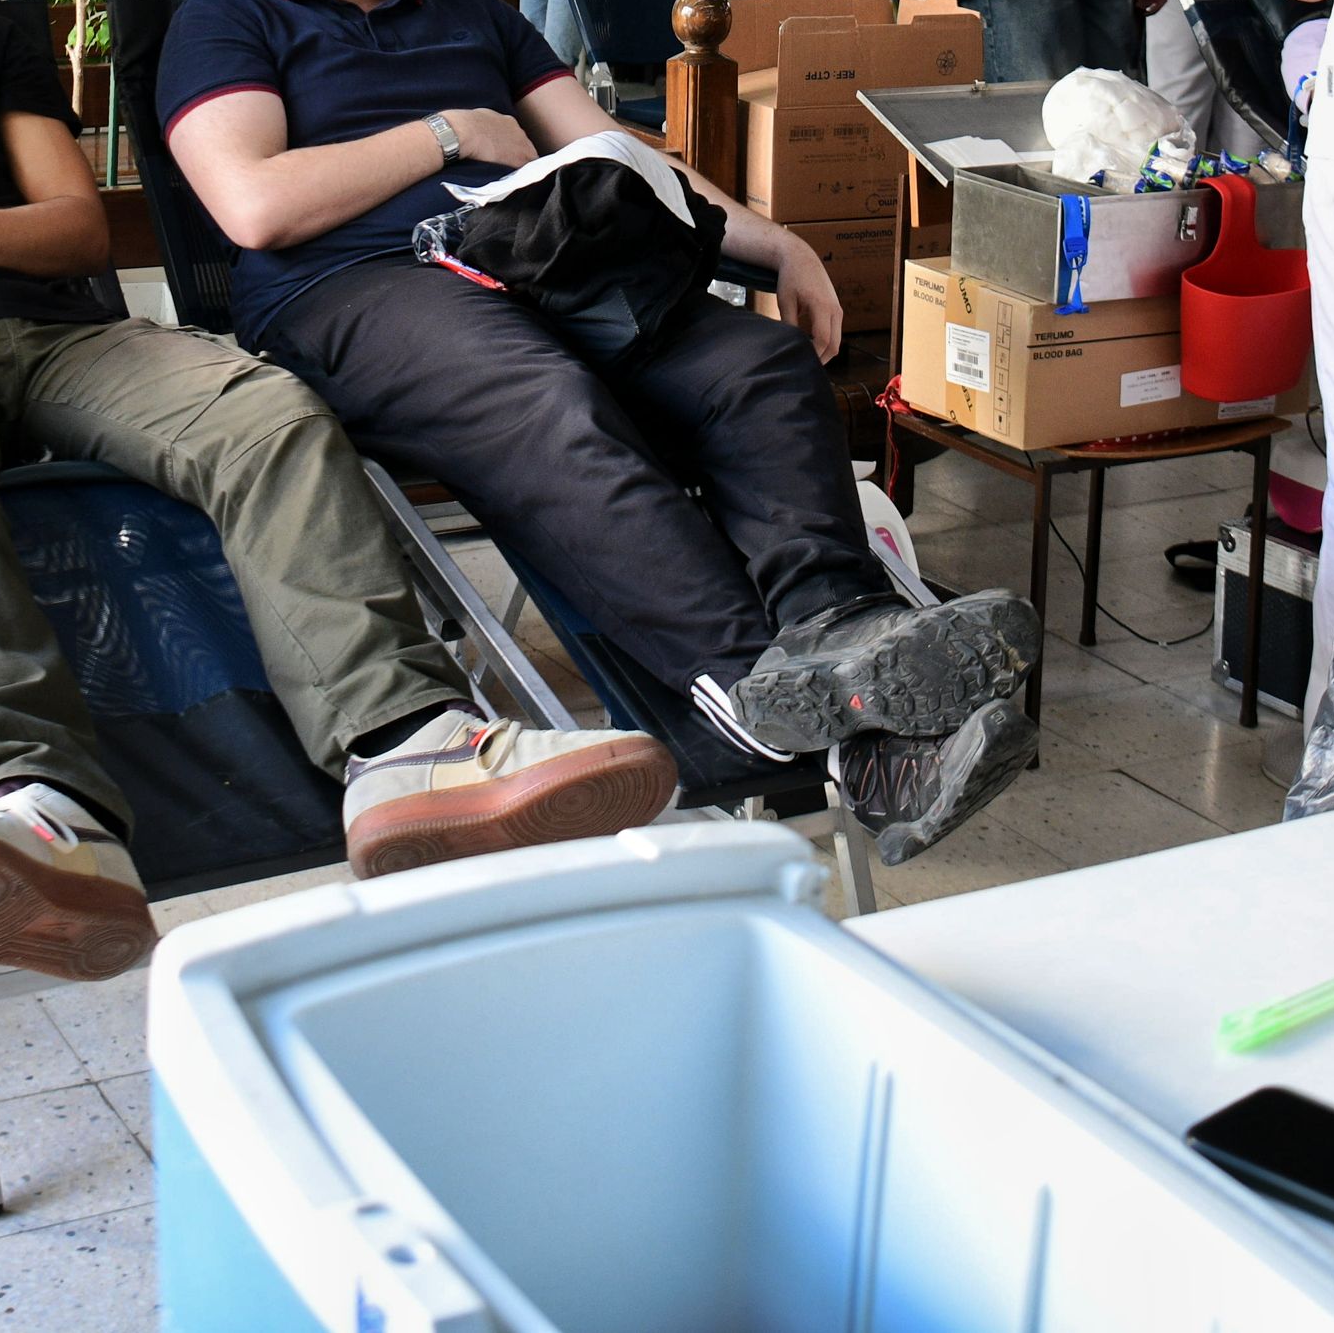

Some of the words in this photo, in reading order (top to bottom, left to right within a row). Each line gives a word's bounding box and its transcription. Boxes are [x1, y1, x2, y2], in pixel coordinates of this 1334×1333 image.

[804, 69, 831, 81] CTPF
[834, 69, 856, 80] REF:
[835, 228, 893, 243] macopharma
[914, 276, 945, 294] TERUMO
[913, 289, 934, 303] BLOOD
[1034, 330, 1075, 341] TERUMO
[1032, 349, 1064, 361] BLOOD
[1065, 348, 1083, 358] BAG
